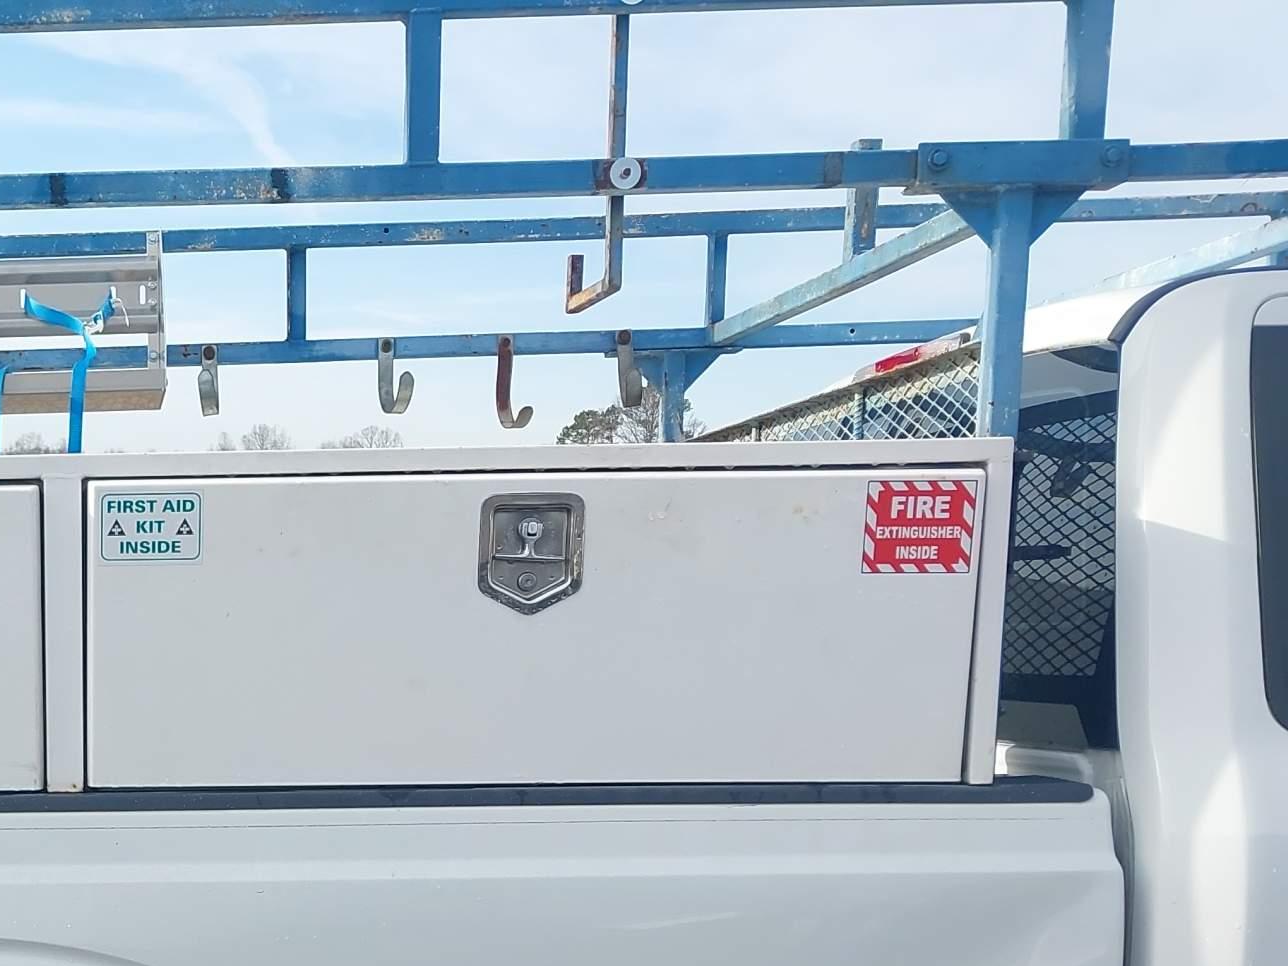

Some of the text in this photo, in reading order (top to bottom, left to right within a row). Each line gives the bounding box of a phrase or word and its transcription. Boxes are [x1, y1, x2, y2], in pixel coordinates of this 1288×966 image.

[106, 499, 195, 514] FIRST AID
[890, 495, 952, 519] FIRE
[135, 520, 165, 534] KIT
[875, 526, 962, 539] EXTINGUISHER
[119, 540, 182, 554] INSIDE
[895, 545, 939, 559] INSIDE
